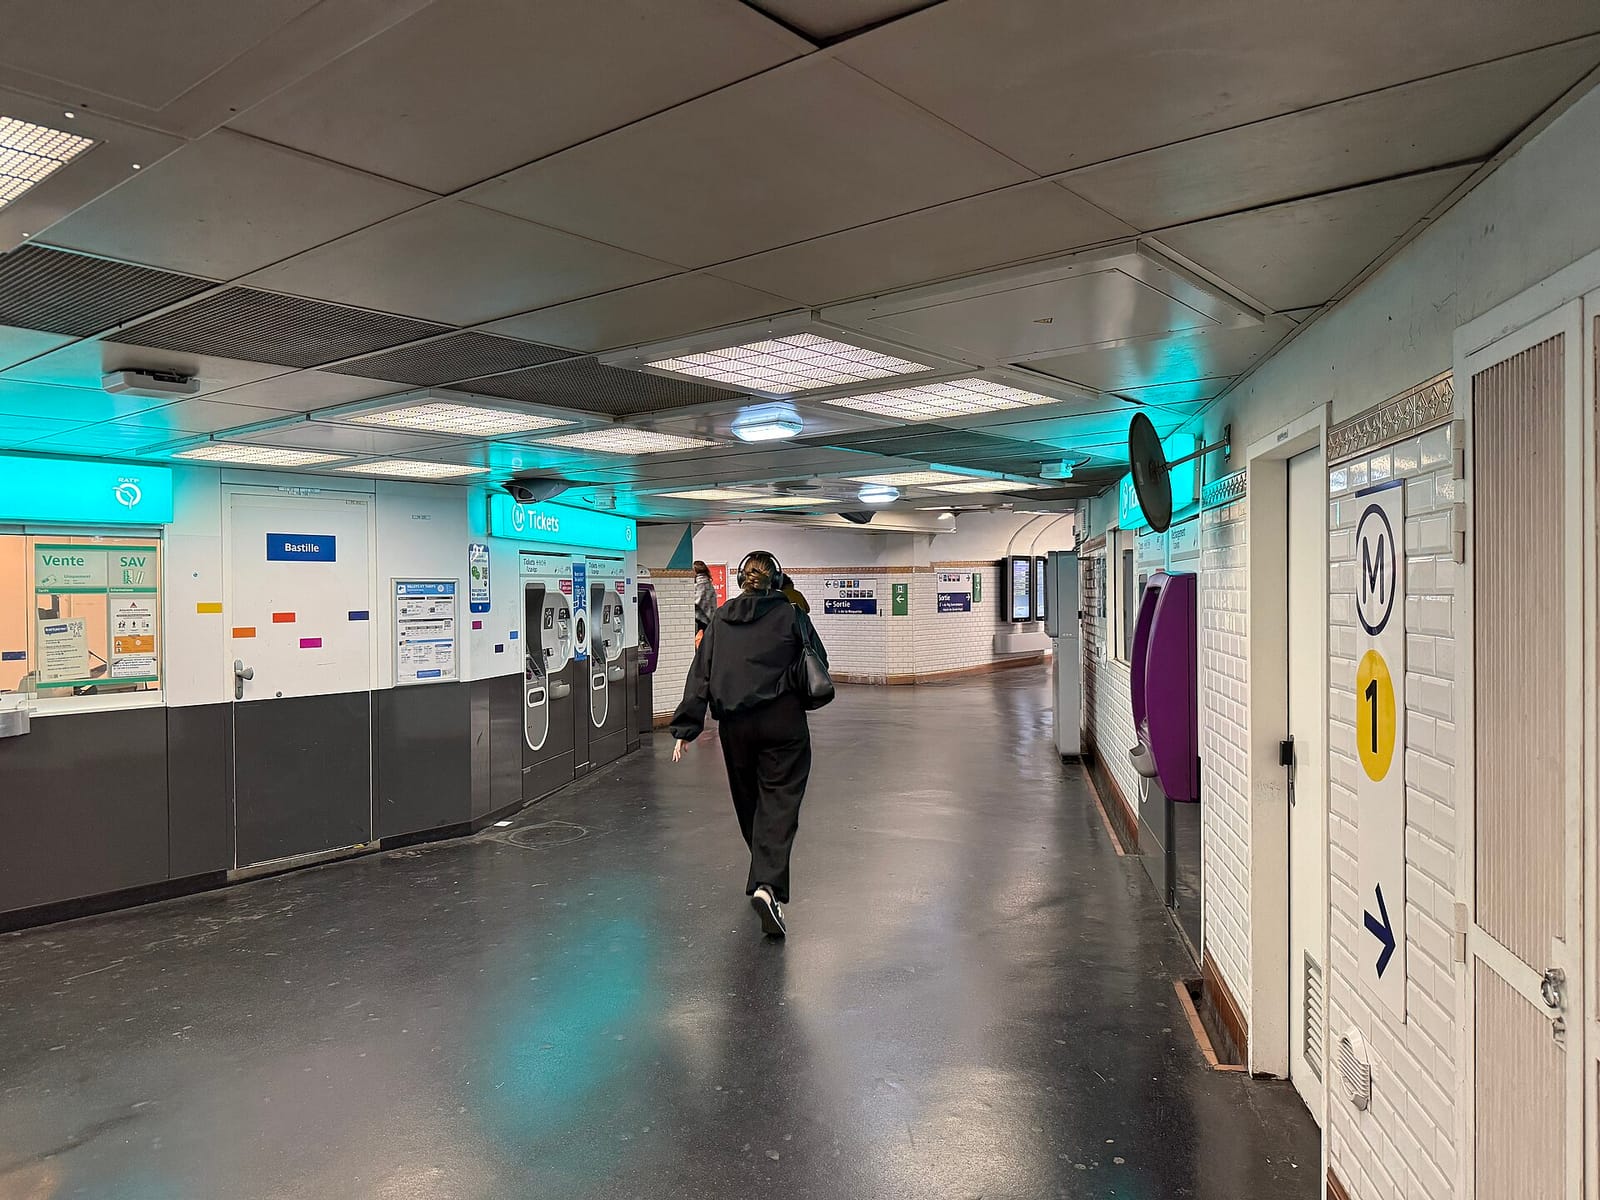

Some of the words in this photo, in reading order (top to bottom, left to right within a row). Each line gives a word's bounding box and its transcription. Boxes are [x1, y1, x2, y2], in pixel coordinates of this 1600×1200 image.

[528, 509, 559, 533] Tickets
[284, 543, 320, 553] Bastille
[42, 555, 85, 566] Vente
[120, 556, 146, 567] SAV
[1362, 532, 1385, 605] M
[1364, 678, 1378, 754] 1
